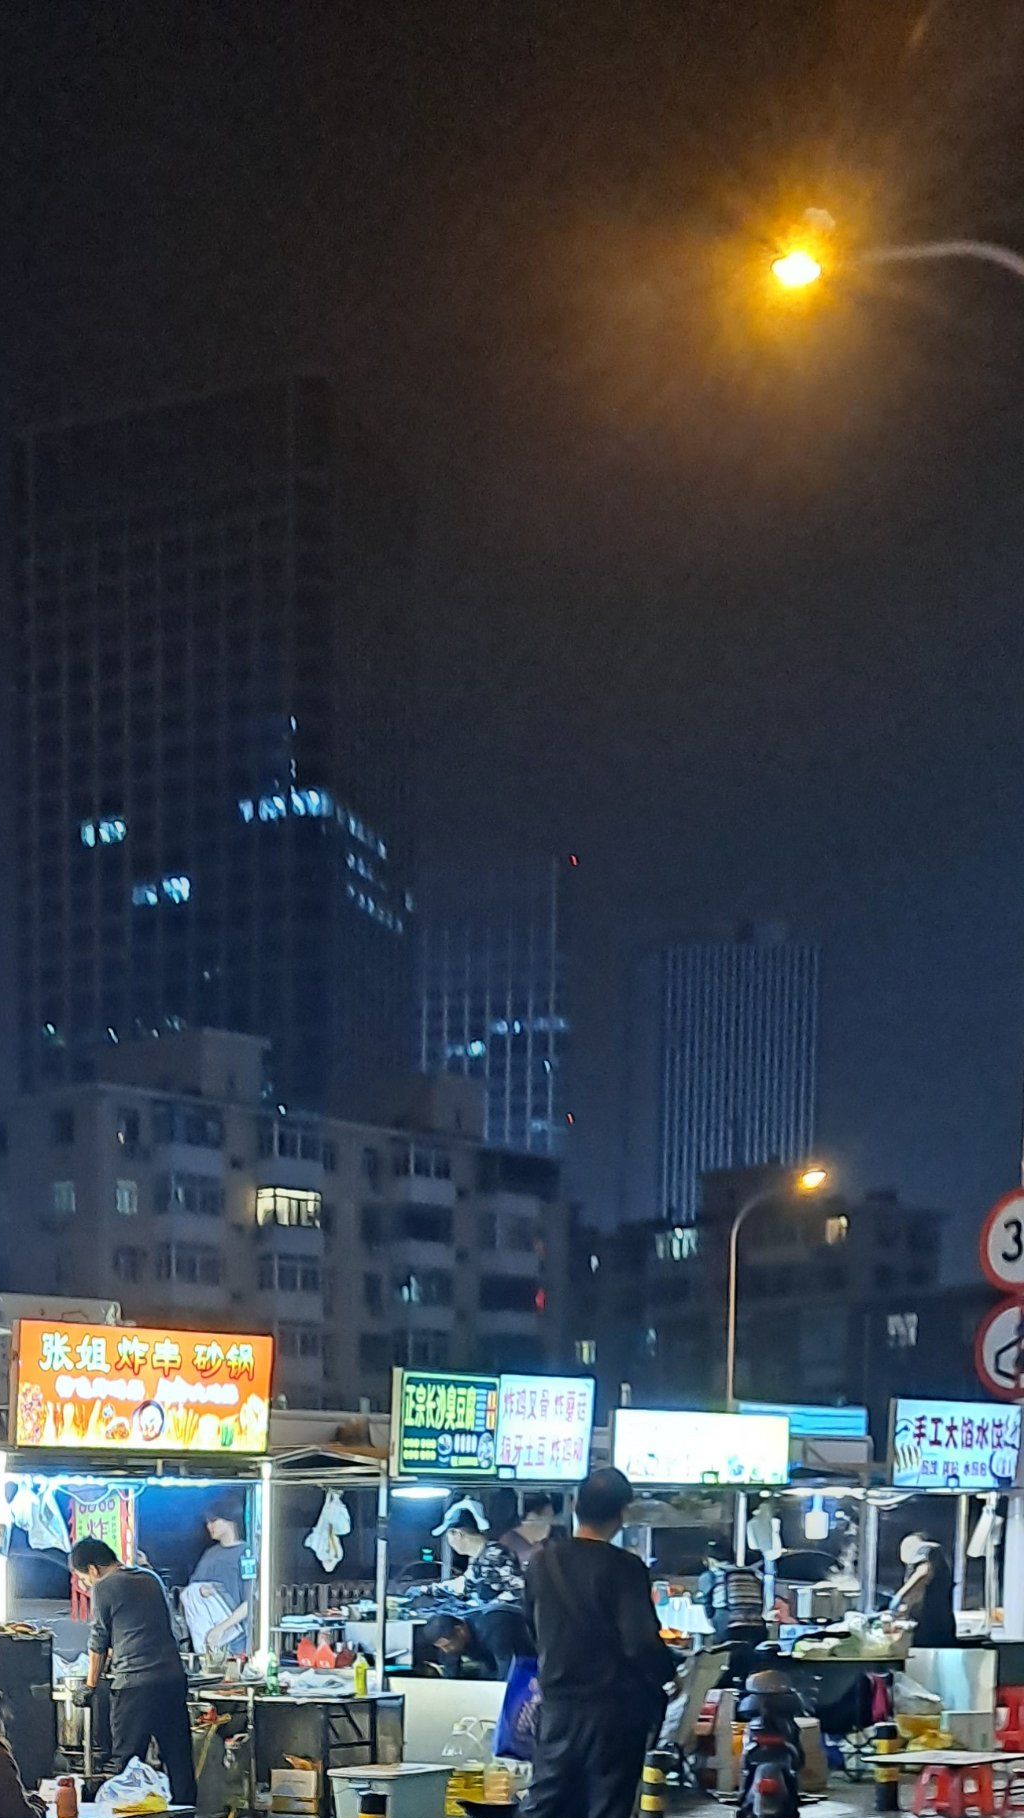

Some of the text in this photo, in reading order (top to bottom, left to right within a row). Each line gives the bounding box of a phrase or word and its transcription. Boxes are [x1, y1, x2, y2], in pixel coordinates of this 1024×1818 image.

[1001, 1217, 1023, 1263] 3
[403, 1383, 477, 1431] 正宗长沙臭豆腐
[913, 1414, 1004, 1450] 手工大馅水饺
